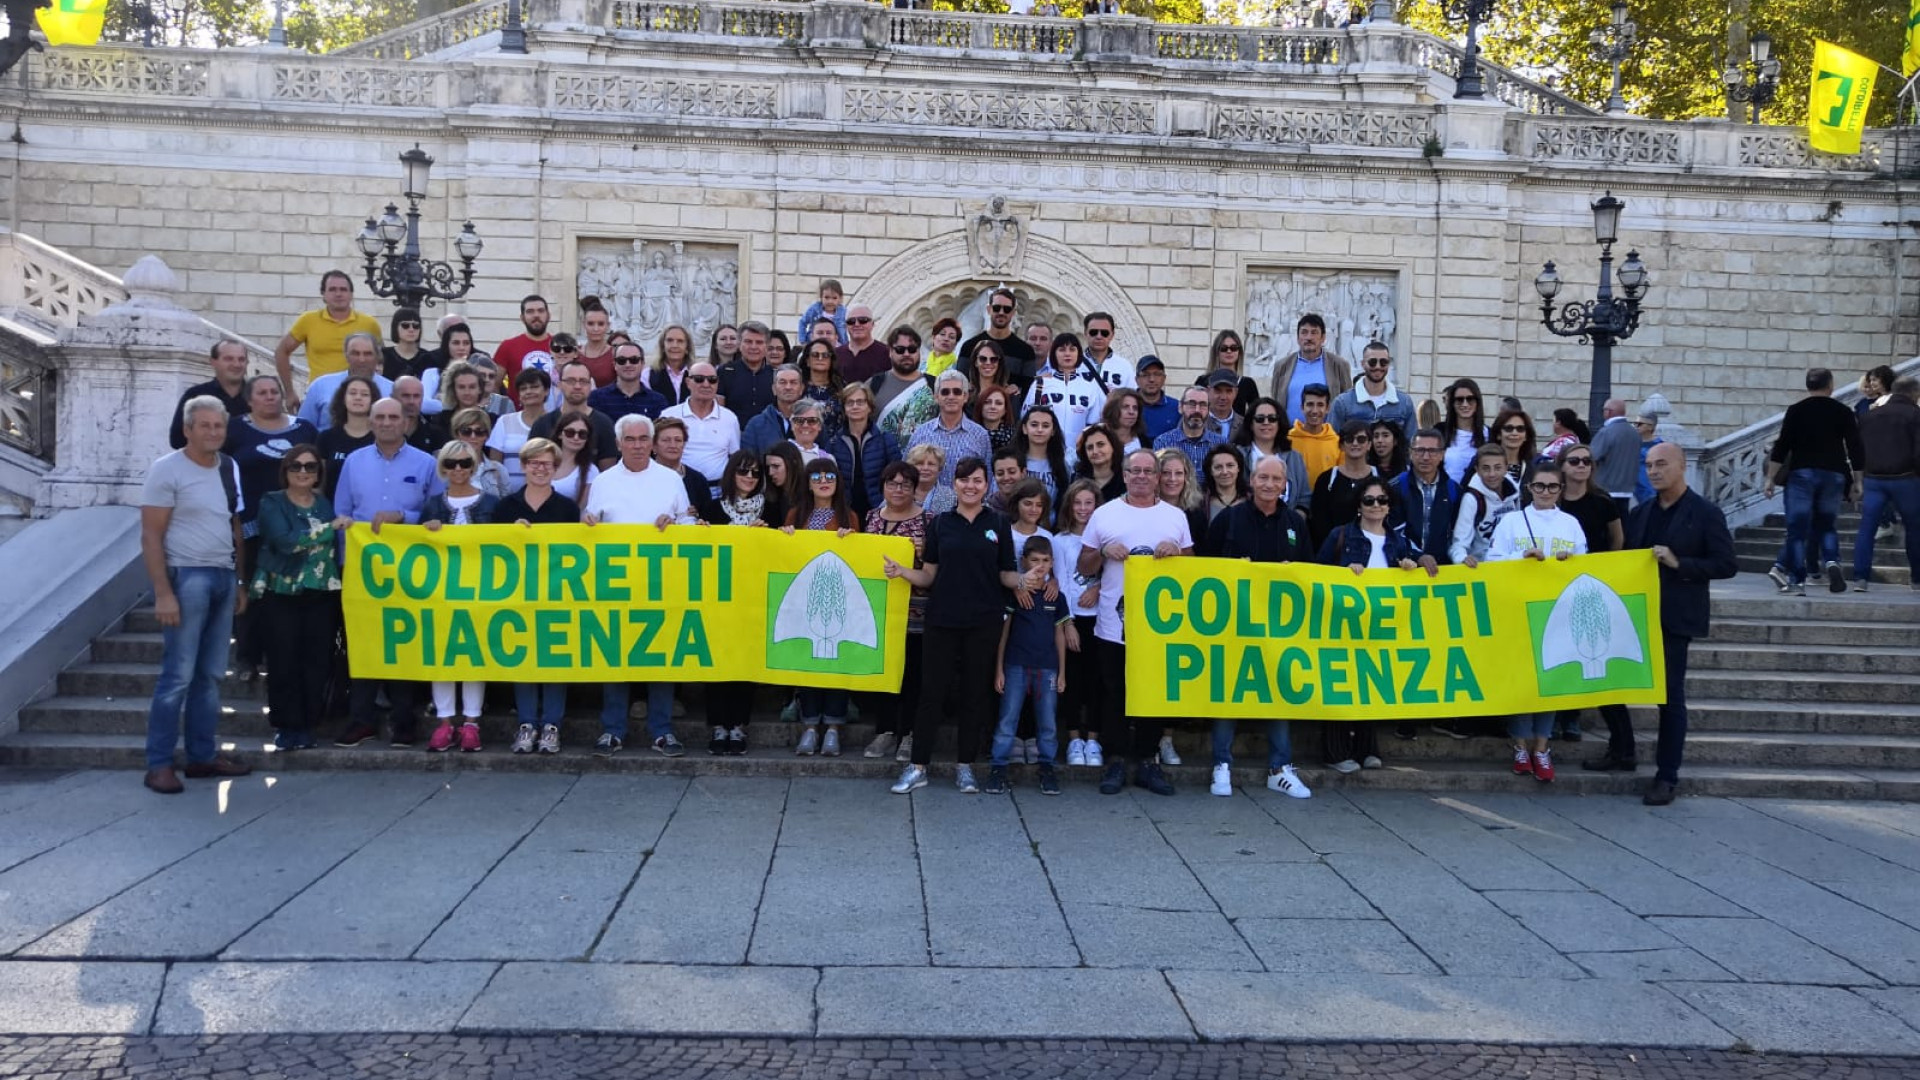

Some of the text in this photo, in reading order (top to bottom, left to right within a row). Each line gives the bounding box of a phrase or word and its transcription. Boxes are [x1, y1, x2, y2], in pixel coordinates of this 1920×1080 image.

[361, 543, 732, 602] COLDIRETTI
[383, 607, 713, 668] PIACENZA
[1144, 576, 1493, 640] COLDIRETTI
[1166, 643, 1485, 705] PIACENZA
